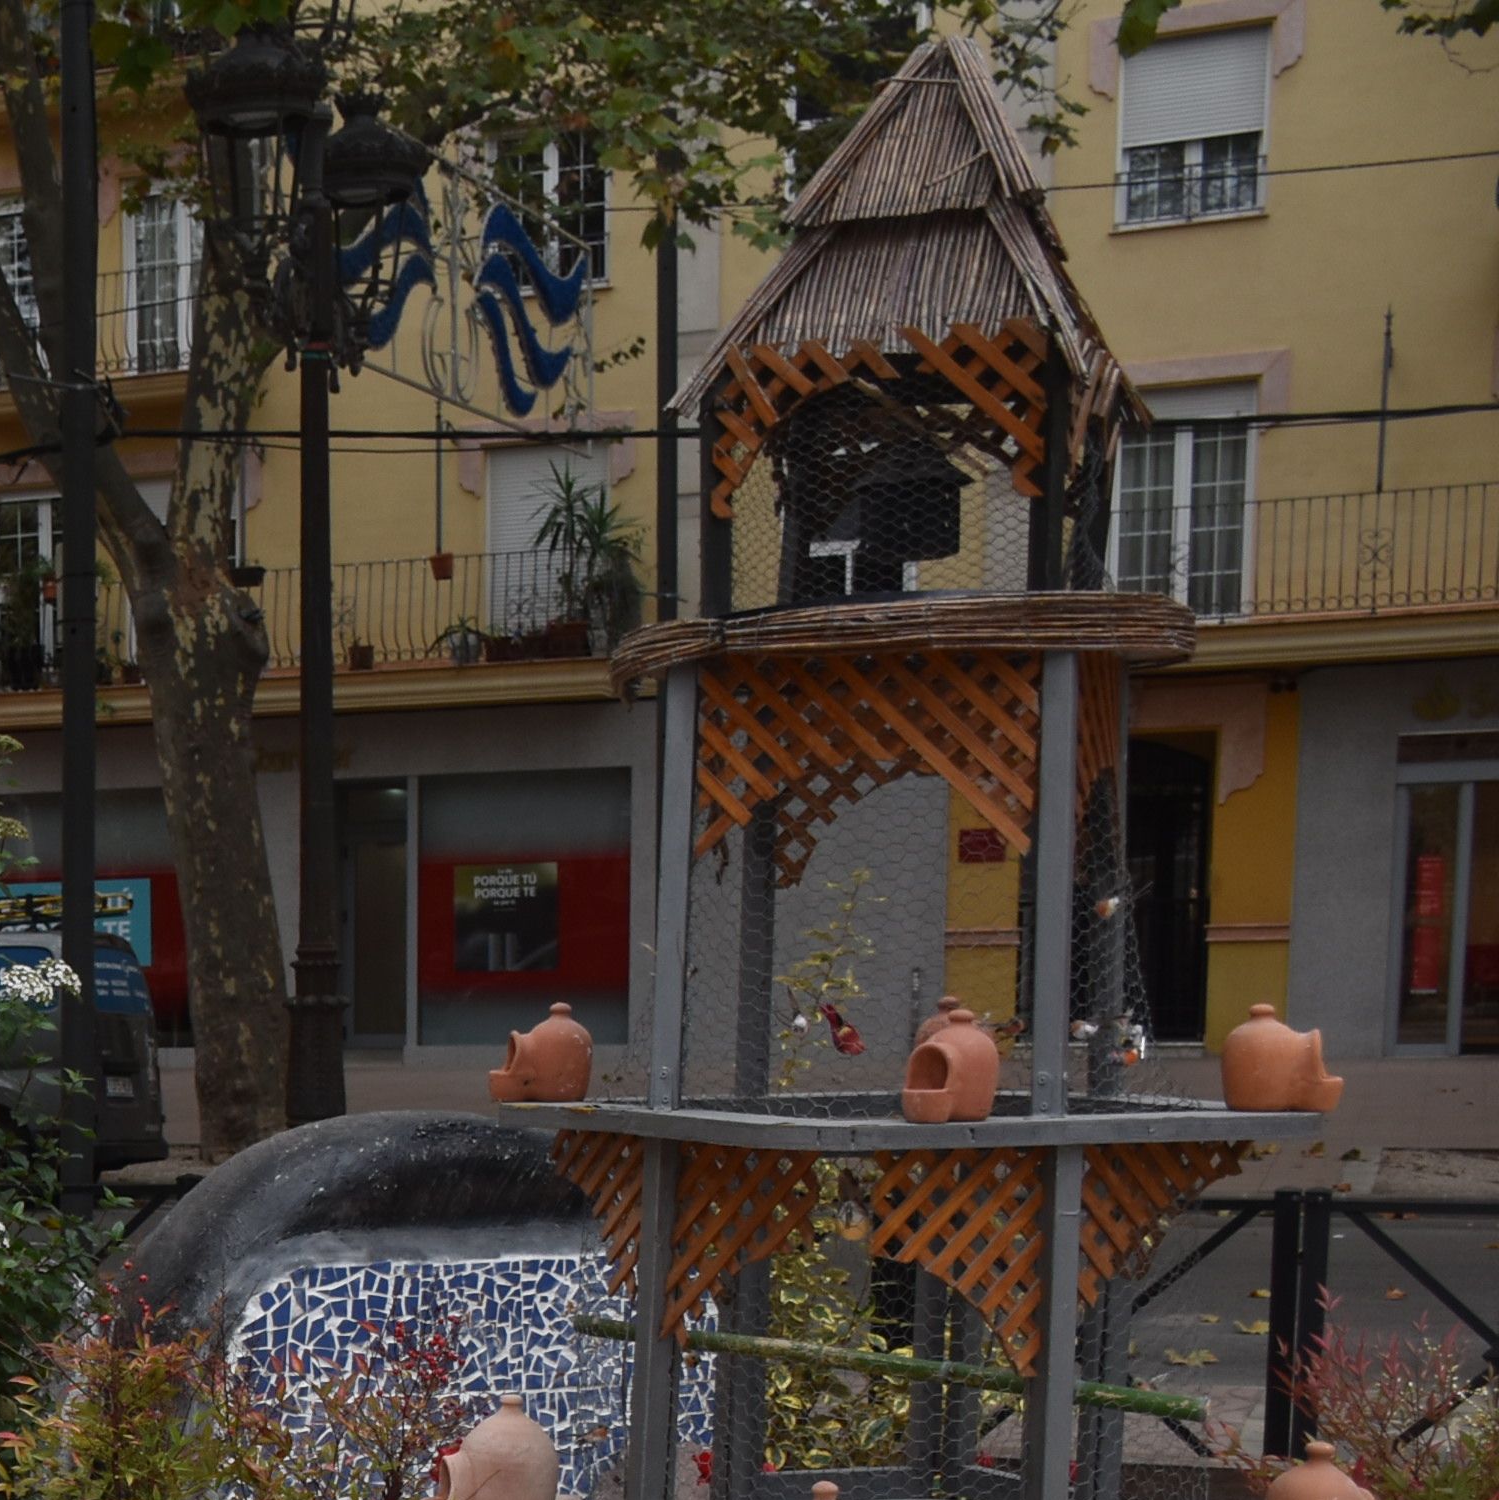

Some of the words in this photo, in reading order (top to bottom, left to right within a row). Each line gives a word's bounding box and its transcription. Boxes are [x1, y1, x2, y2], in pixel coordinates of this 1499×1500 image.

[473, 874, 520, 887] PORQUE
[522, 871, 537, 885] TÚ
[474, 887, 521, 899] PORQUE
[522, 886, 537, 897] TE
[102, 920, 131, 941] TE
